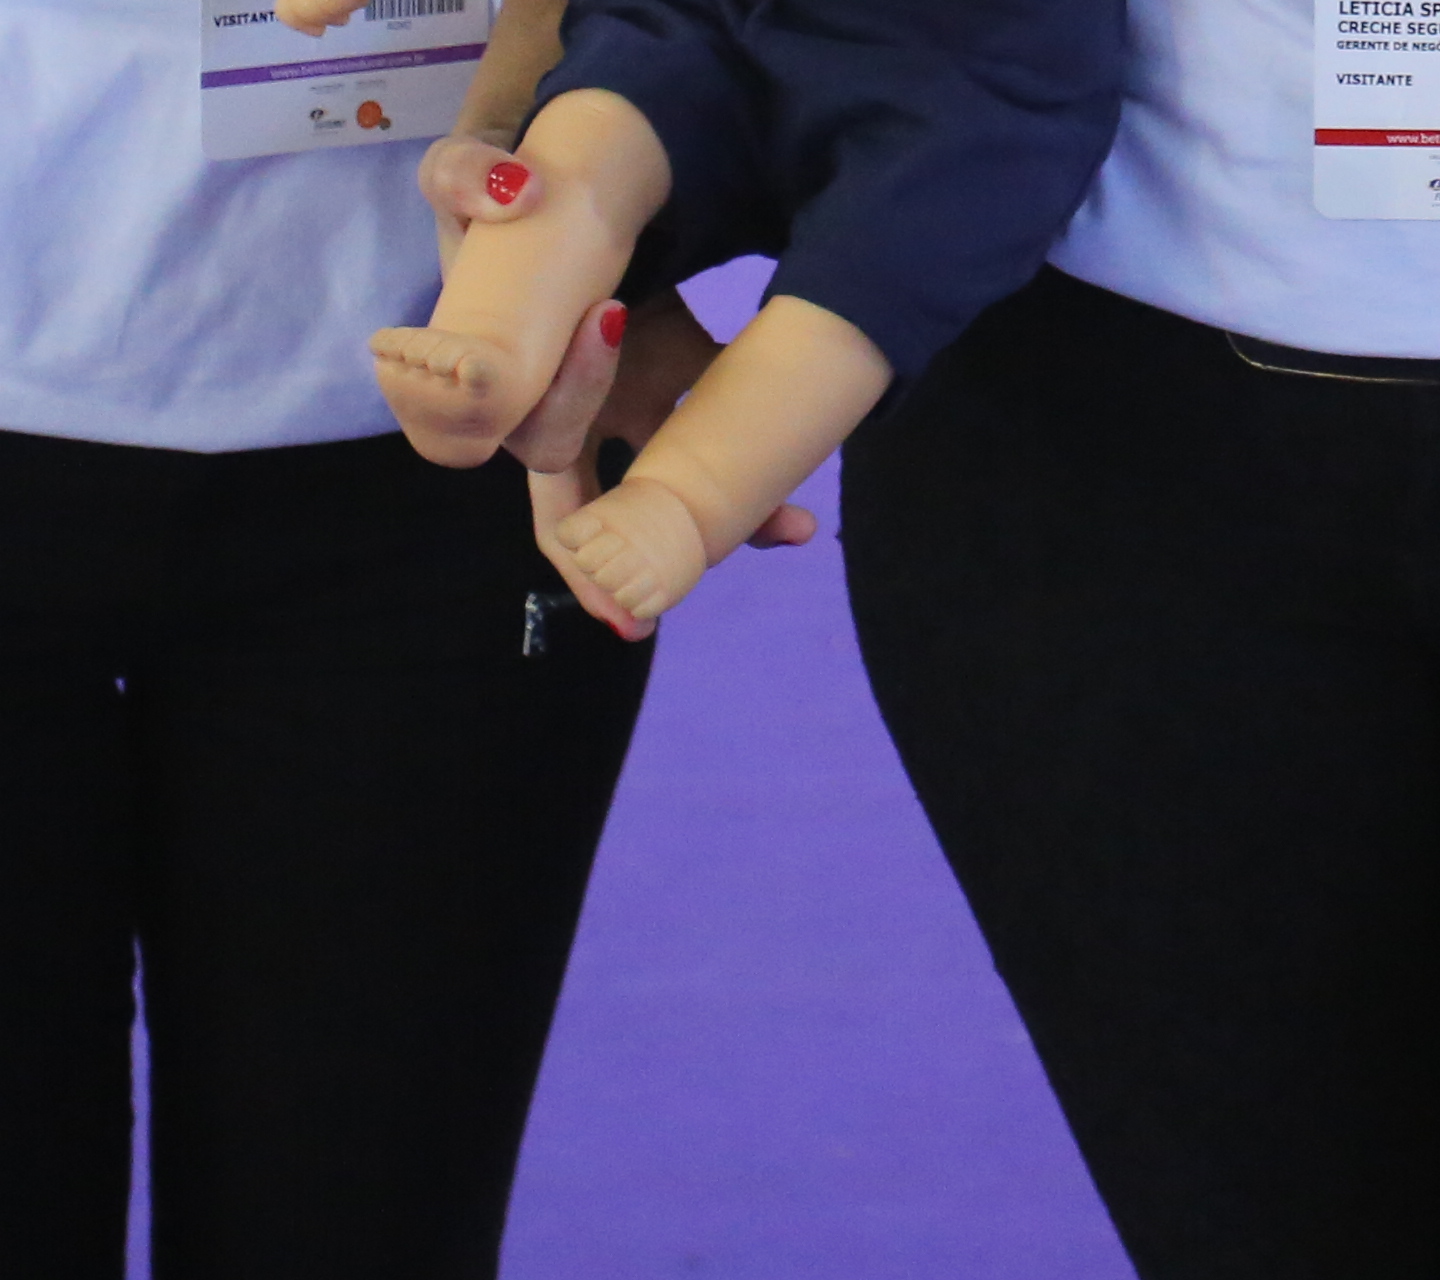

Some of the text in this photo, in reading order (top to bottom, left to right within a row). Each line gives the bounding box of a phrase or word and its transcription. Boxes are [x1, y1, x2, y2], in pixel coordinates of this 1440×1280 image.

[1339, 0, 1414, 17] LETICIA
[214, 11, 278, 27] VISITANT
[1338, 20, 1402, 35] CRECHE
[1336, 40, 1390, 51] GERENTE
[1393, 41, 1408, 52] DE
[1336, 73, 1413, 86] VISITANTE
